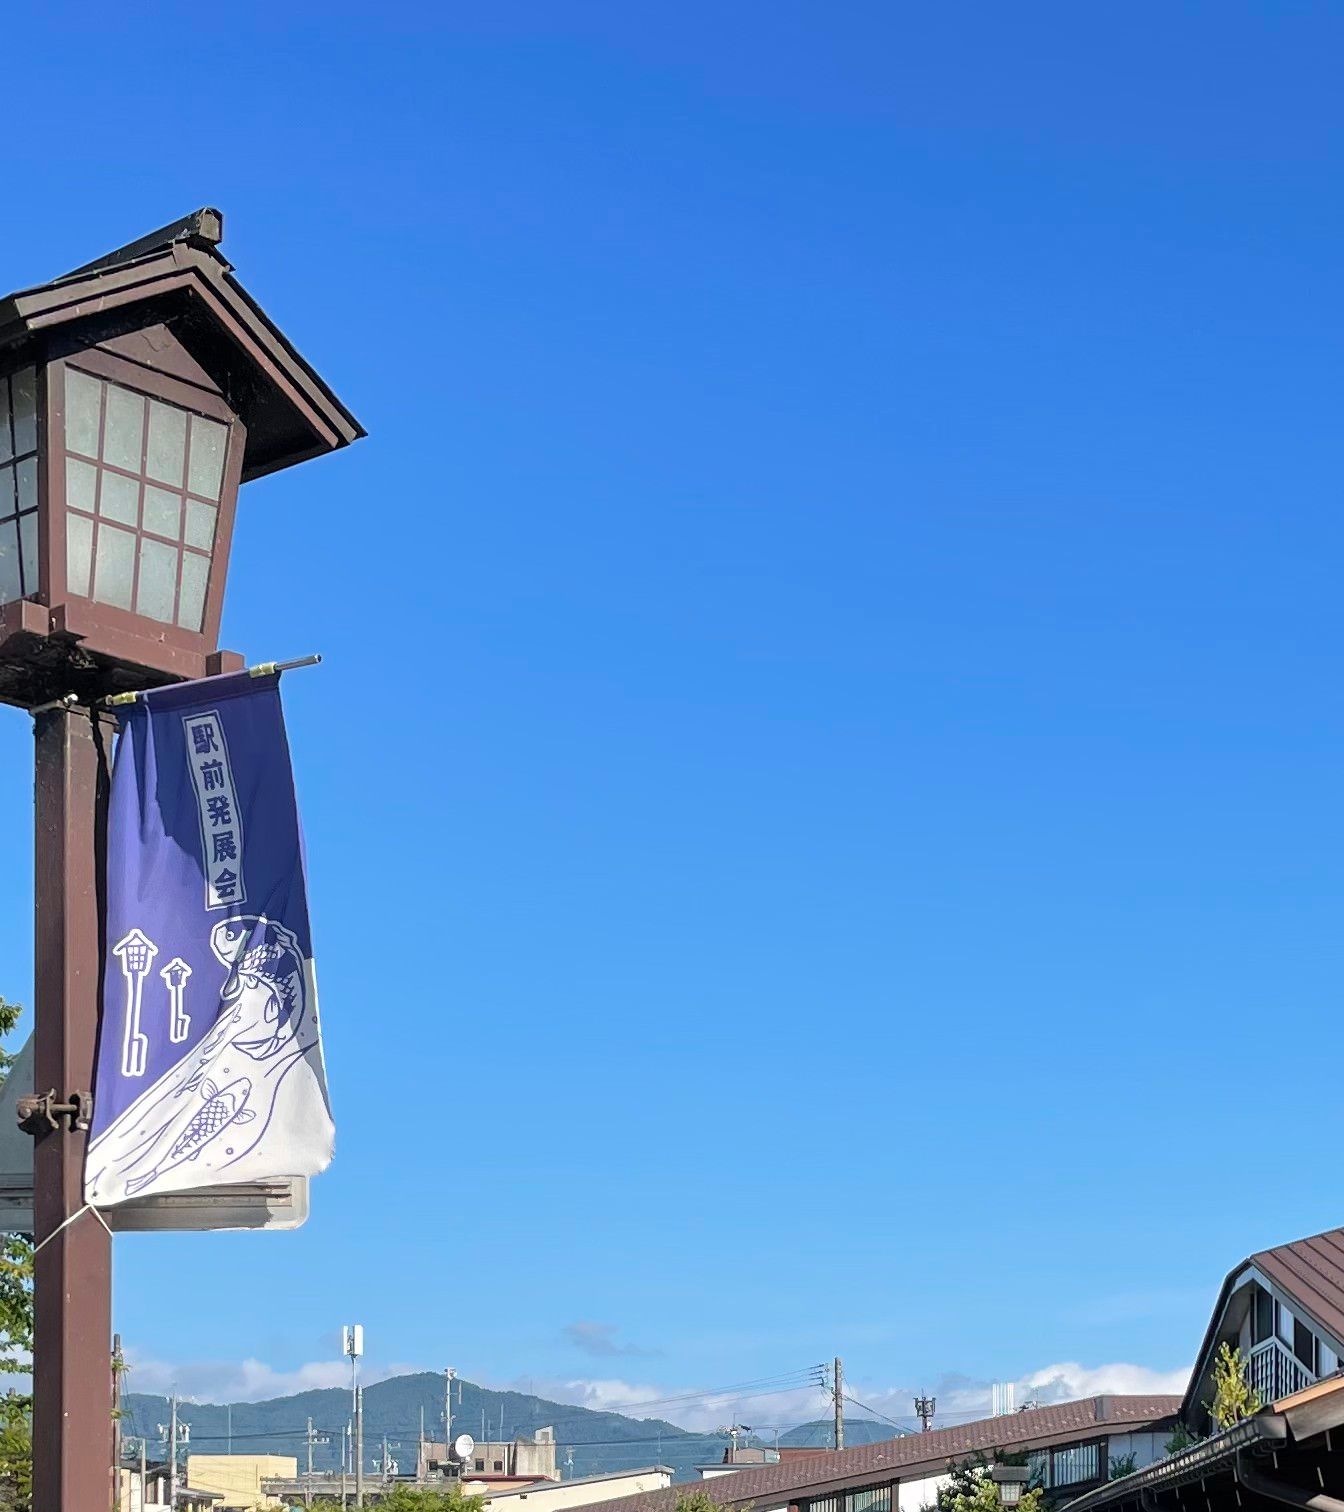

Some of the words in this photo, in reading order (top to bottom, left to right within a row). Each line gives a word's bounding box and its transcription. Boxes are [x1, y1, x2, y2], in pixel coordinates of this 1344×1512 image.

[191, 722, 237, 900] 駅前発展会
